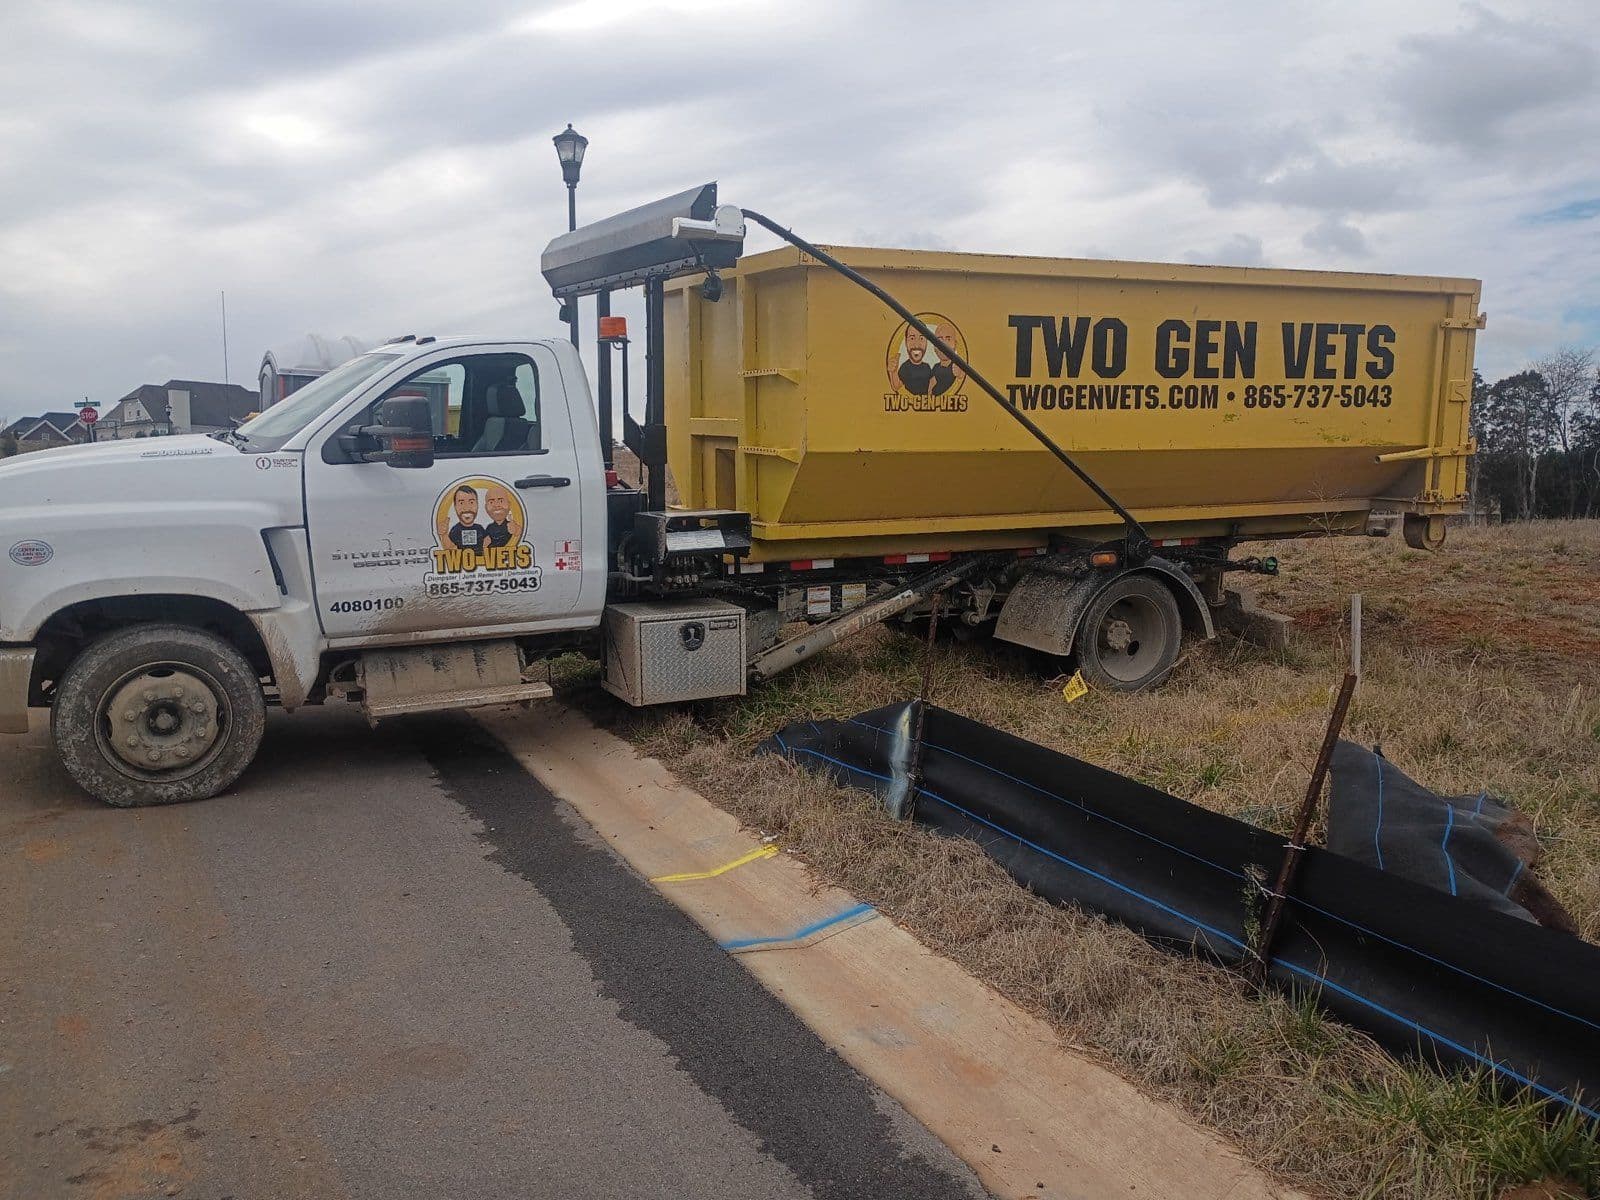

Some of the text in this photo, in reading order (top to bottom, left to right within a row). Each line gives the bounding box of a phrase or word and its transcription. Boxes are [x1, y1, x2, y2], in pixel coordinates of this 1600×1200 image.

[1008, 315, 1396, 379] TWO GEN VETS
[1006, 384, 1393, 410] TWOGENVETS.COM 865-737-5043
[81, 411, 97, 420] STOP
[331, 548, 429, 560] SILVERADO
[427, 574, 458, 582] Dumpster
[478, 569, 504, 578] Removal
[508, 568, 540, 577] Demolition
[429, 577, 538, 596] 865-737-5043
[330, 597, 404, 613] 4080100
